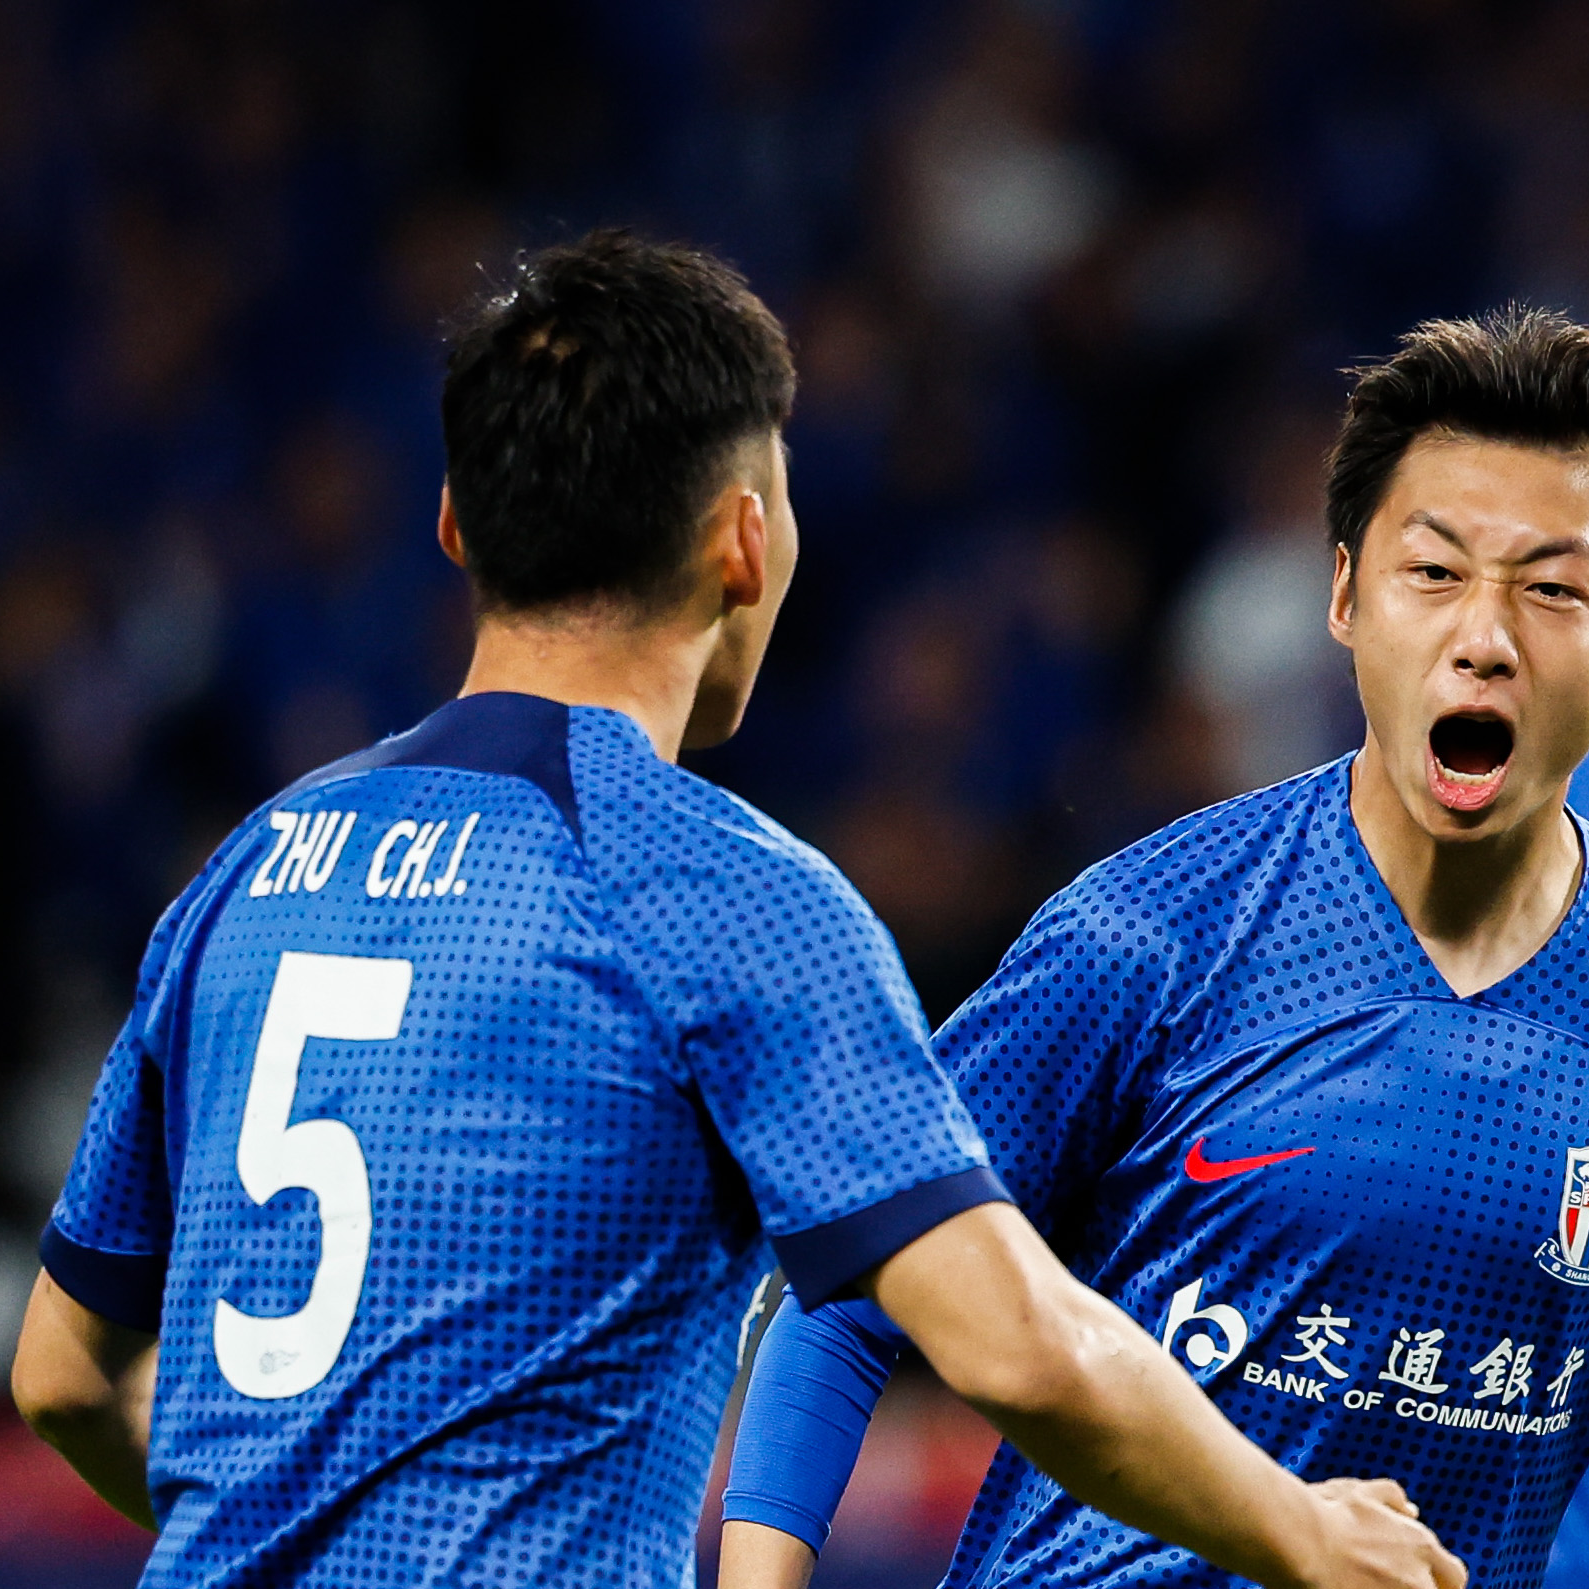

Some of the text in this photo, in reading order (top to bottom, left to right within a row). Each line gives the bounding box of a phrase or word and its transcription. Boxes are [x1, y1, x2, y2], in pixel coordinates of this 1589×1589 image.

[249, 811, 481, 899] ZHU CH.J.
[213, 951, 412, 1400] 5
[1243, 1361, 1330, 1402] BANK
[1343, 1389, 1385, 1411] OF
